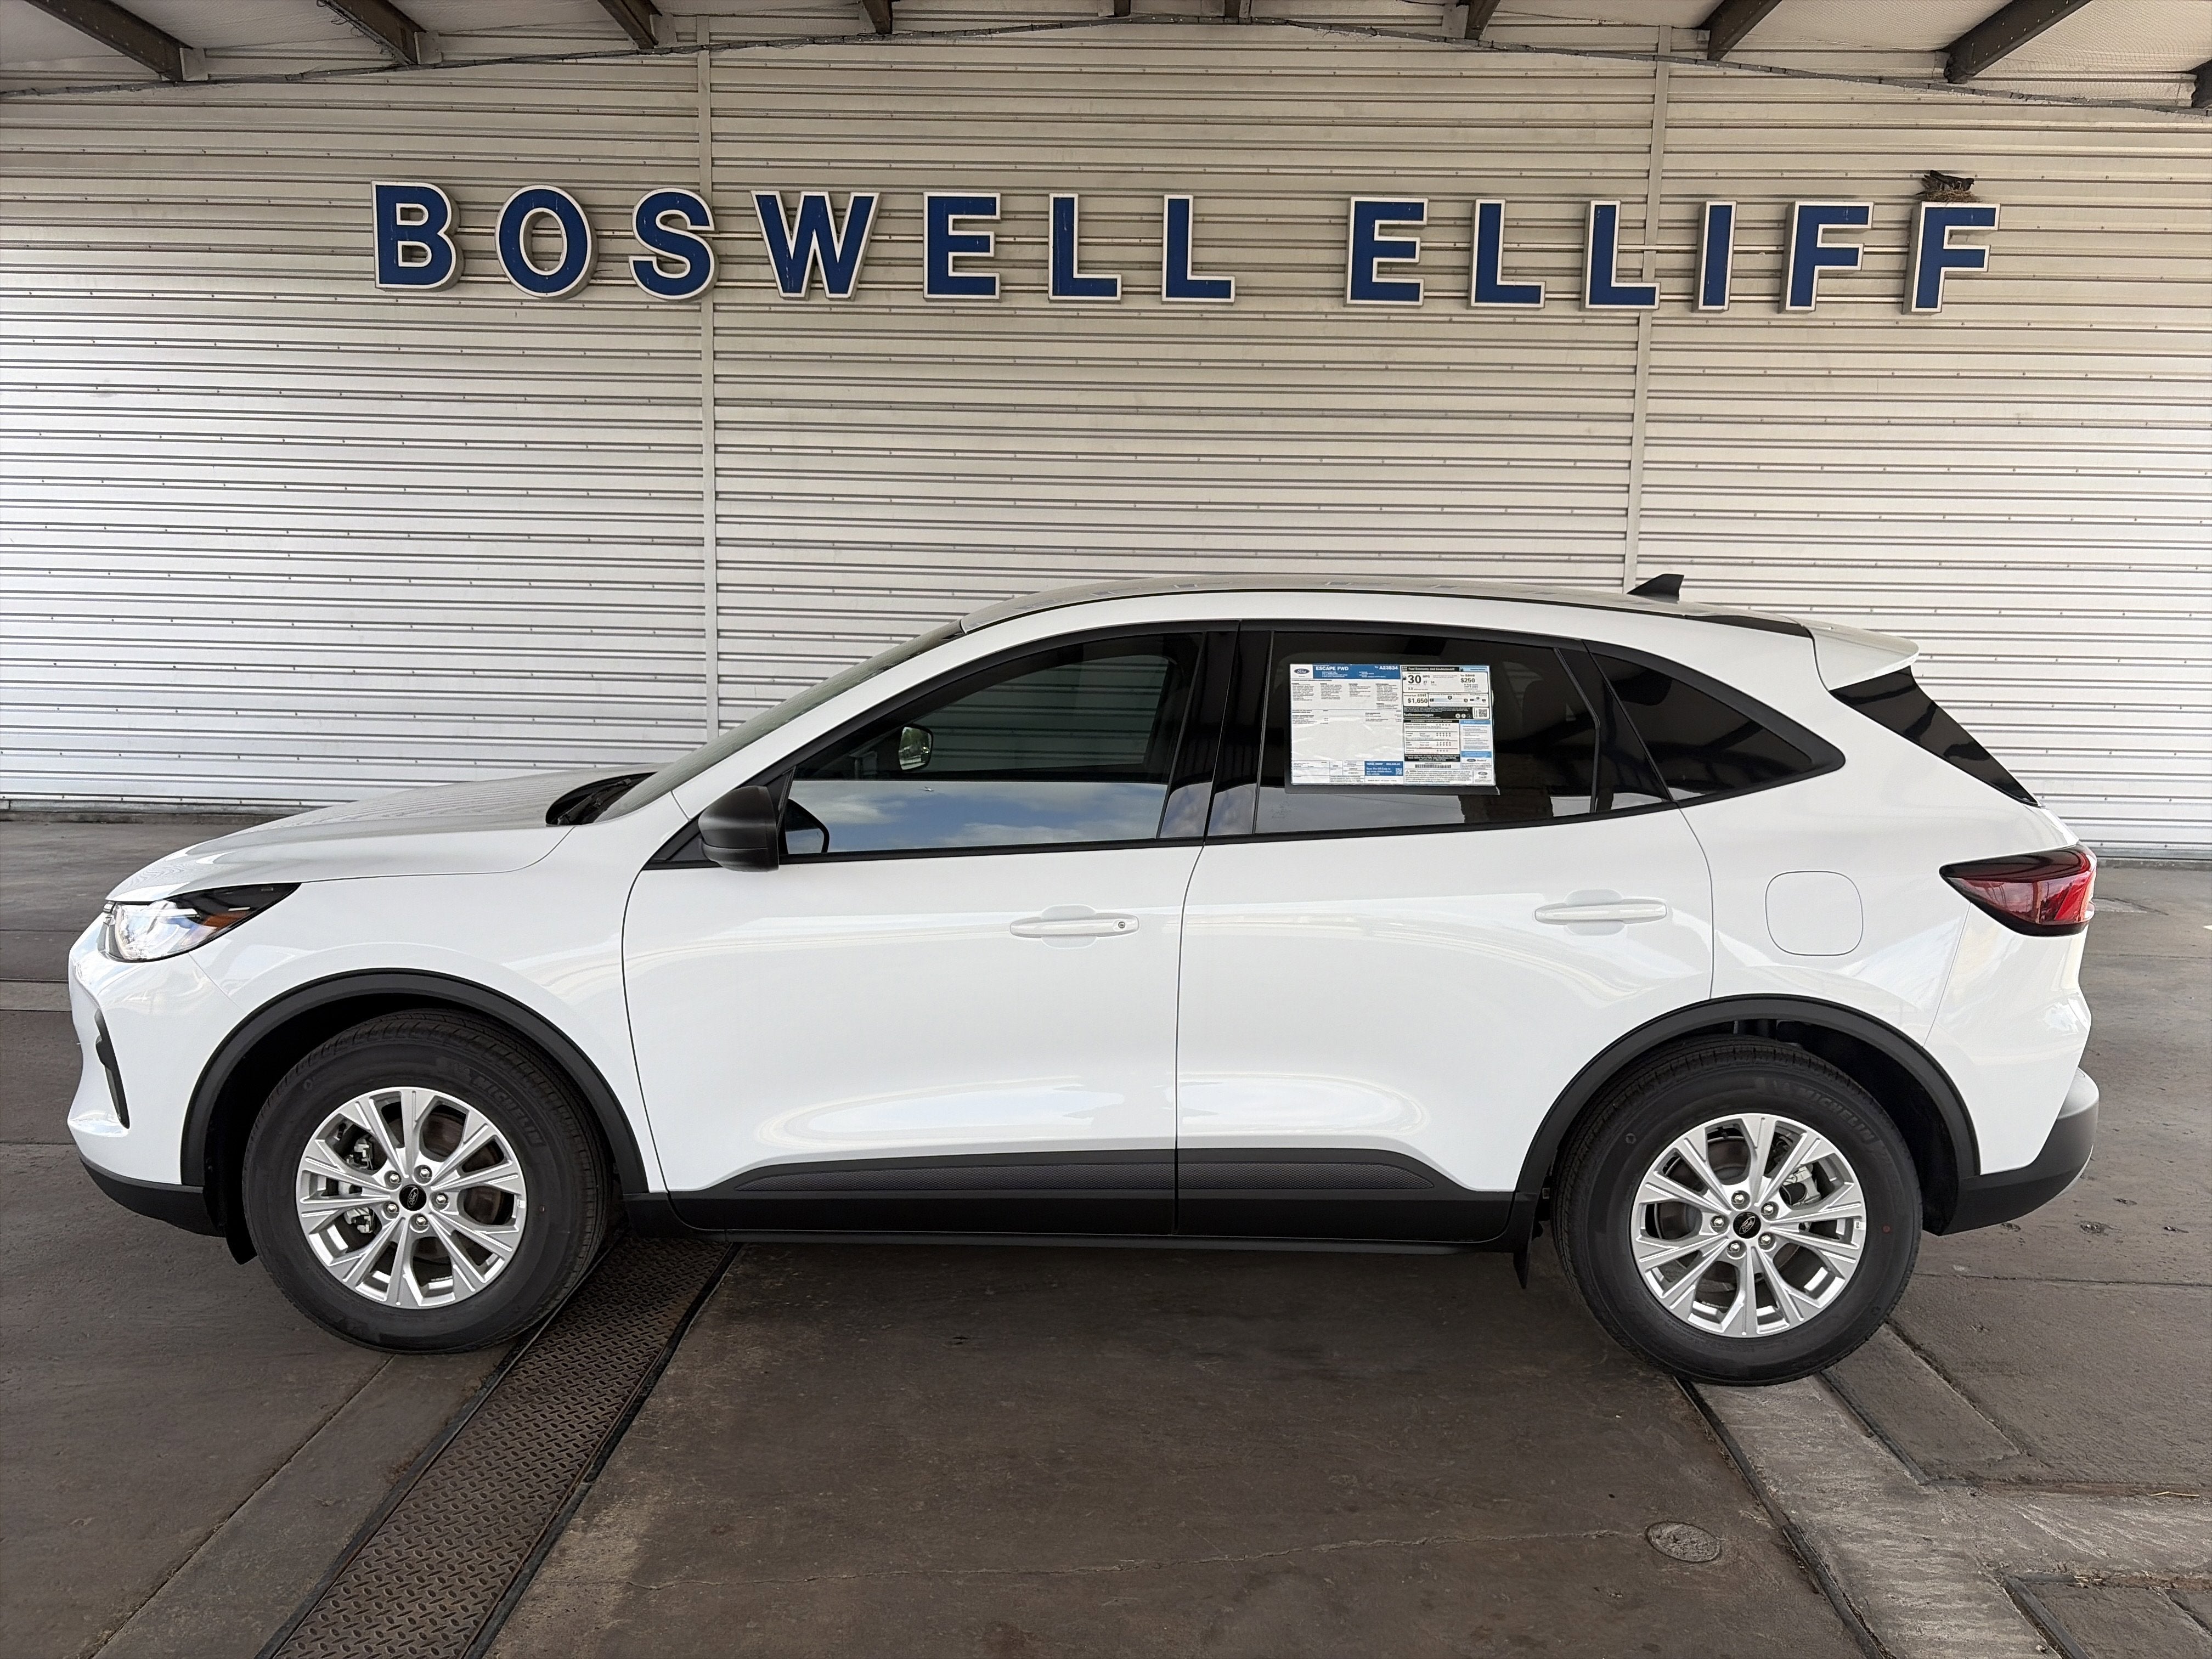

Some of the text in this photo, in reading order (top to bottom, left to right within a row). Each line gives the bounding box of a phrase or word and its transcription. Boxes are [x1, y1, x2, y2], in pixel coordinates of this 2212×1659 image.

[370, 180, 2001, 314] BOSWELL ELLIFF
[1408, 675, 1421, 684] 30
[472, 1075, 543, 1144] MICHELIN
[1799, 1088, 1875, 1142] MICHELIN
